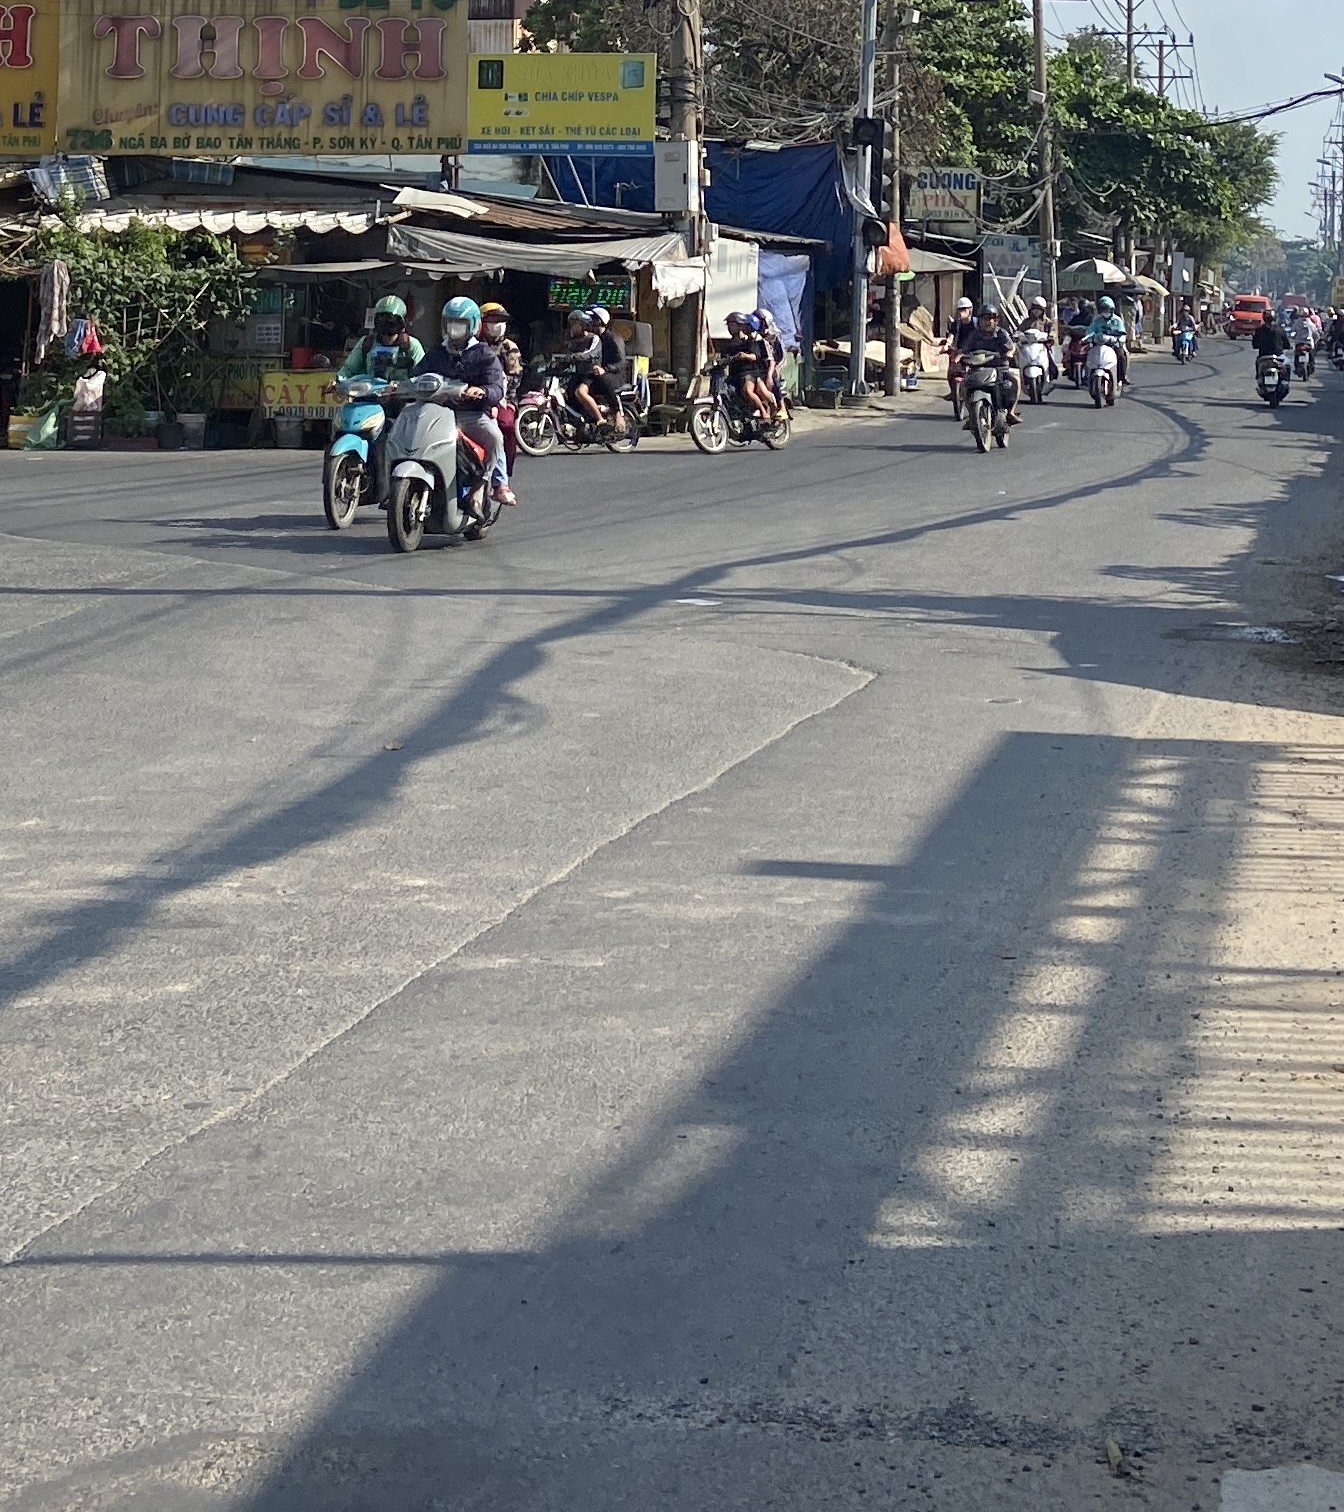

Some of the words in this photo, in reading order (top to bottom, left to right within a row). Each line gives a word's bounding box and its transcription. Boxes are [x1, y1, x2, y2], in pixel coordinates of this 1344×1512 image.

[93, 14, 448, 97] THỊNH
[12, 91, 46, 128] LẺ
[168, 101, 246, 127] CUNG
[255, 94, 312, 128] CẤP
[323, 93, 354, 127] SỈ
[361, 102, 384, 127] &
[395, 93, 430, 128] LẺ
[534, 90, 558, 102] CHÌA
[588, 91, 619, 102] VESPA
[119, 135, 145, 150] NGÃ
[149, 138, 168, 150] BA
[196, 137, 222, 150] BAO
[227, 134, 253, 150] TÂN
[258, 134, 302, 150] THẮNG
[328, 136, 356, 150] SƠN
[408, 135, 432, 150] TÂN
[437, 134, 463, 151] PHÚ
